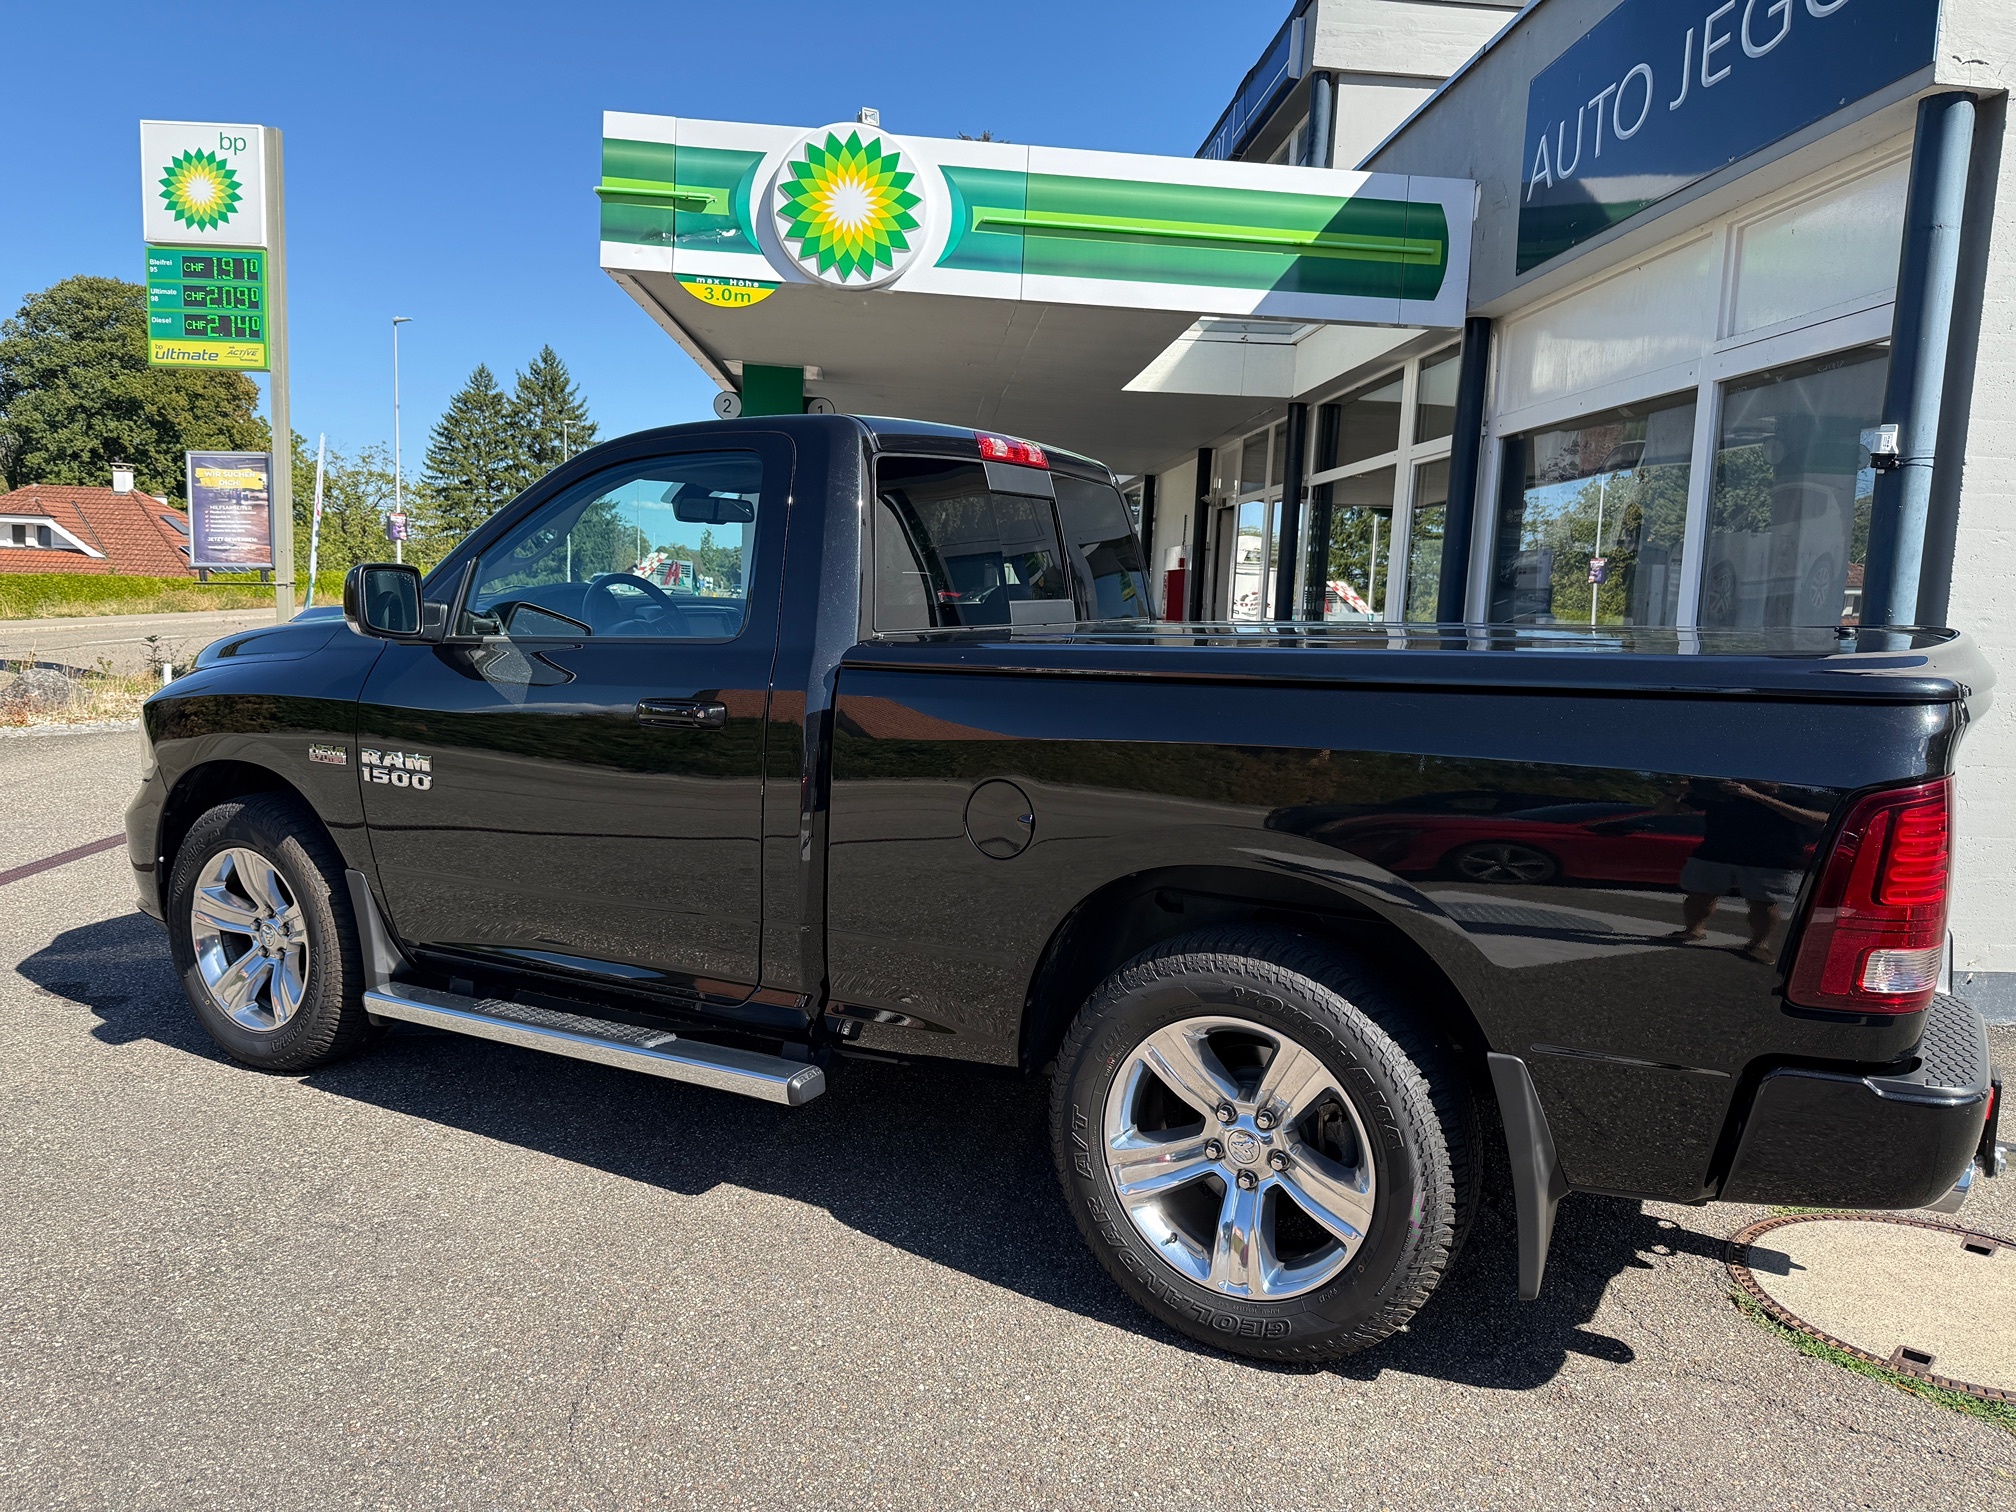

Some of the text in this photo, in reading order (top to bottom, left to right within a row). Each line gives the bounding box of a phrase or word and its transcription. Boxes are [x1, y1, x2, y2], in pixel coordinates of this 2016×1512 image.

[1526, 0, 1850, 203] AUTO JEG
[219, 131, 247, 156] bp
[149, 258, 173, 266] Bleifrei
[183, 262, 205, 272] CHF
[696, 277, 759, 288] max. Höhe
[150, 288, 177, 296] Ultimate
[184, 291, 206, 301] CHF
[703, 286, 752, 303] 3.0m
[151, 316, 172, 324] Diesel
[185, 320, 207, 330] CHF
[155, 347, 219, 362] ultimate
[226, 349, 259, 358] ACTIVE
[722, 398, 732, 413] 2
[817, 404, 823, 414] 1
[204, 470, 221, 478] WIR
[361, 747, 432, 772] RAM
[361, 765, 433, 791] 1500
[1227, 984, 1405, 1151] YOKOHAMA
[1071, 1103, 1292, 1340] GEOLANDAR A/T
